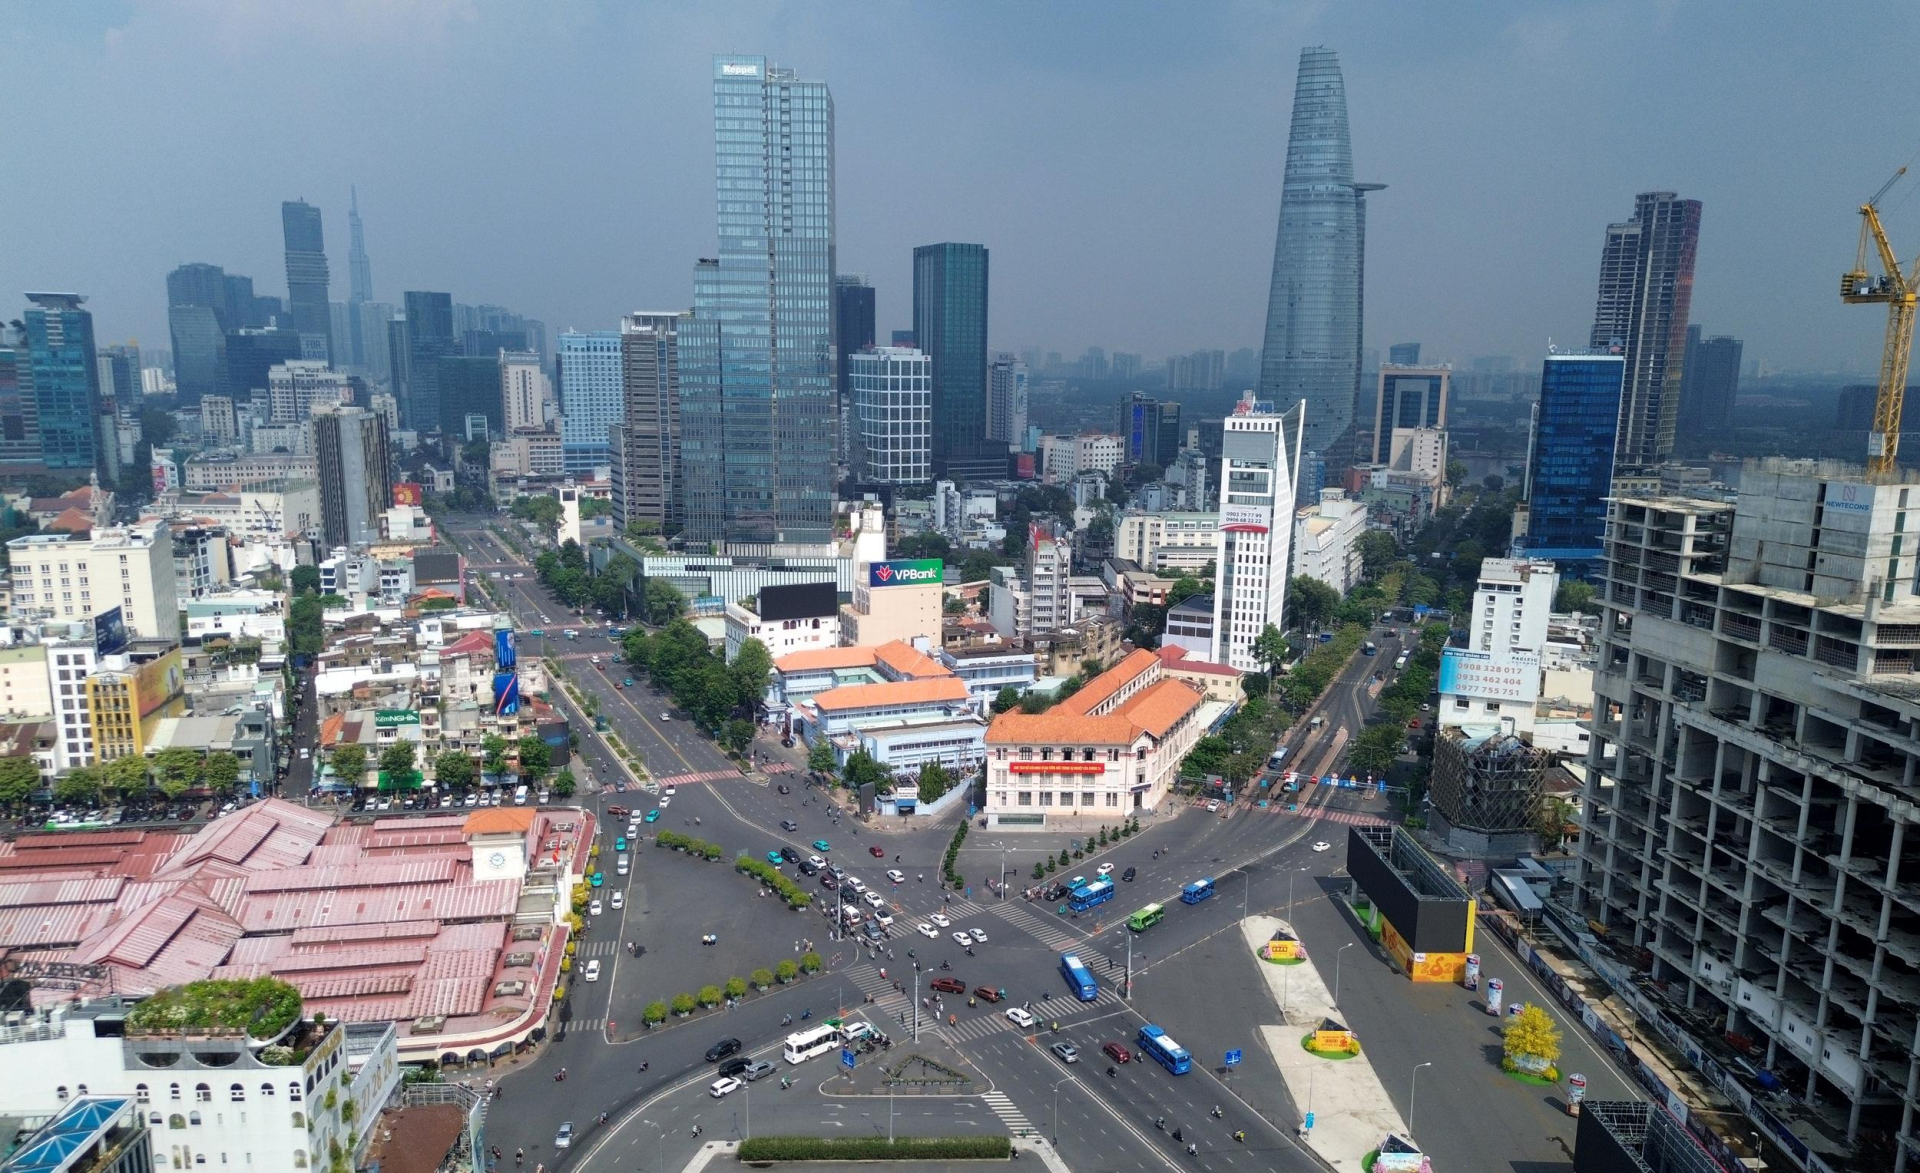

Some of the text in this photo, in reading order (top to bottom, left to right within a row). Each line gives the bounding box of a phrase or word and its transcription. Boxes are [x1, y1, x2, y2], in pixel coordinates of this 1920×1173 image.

[724, 64, 756, 74] Keppel
[306, 340, 321, 349] FOR
[302, 350, 327, 359] LEASE
[1826, 500, 1870, 510] NEWTECONS
[894, 568, 937, 580] VPBank
